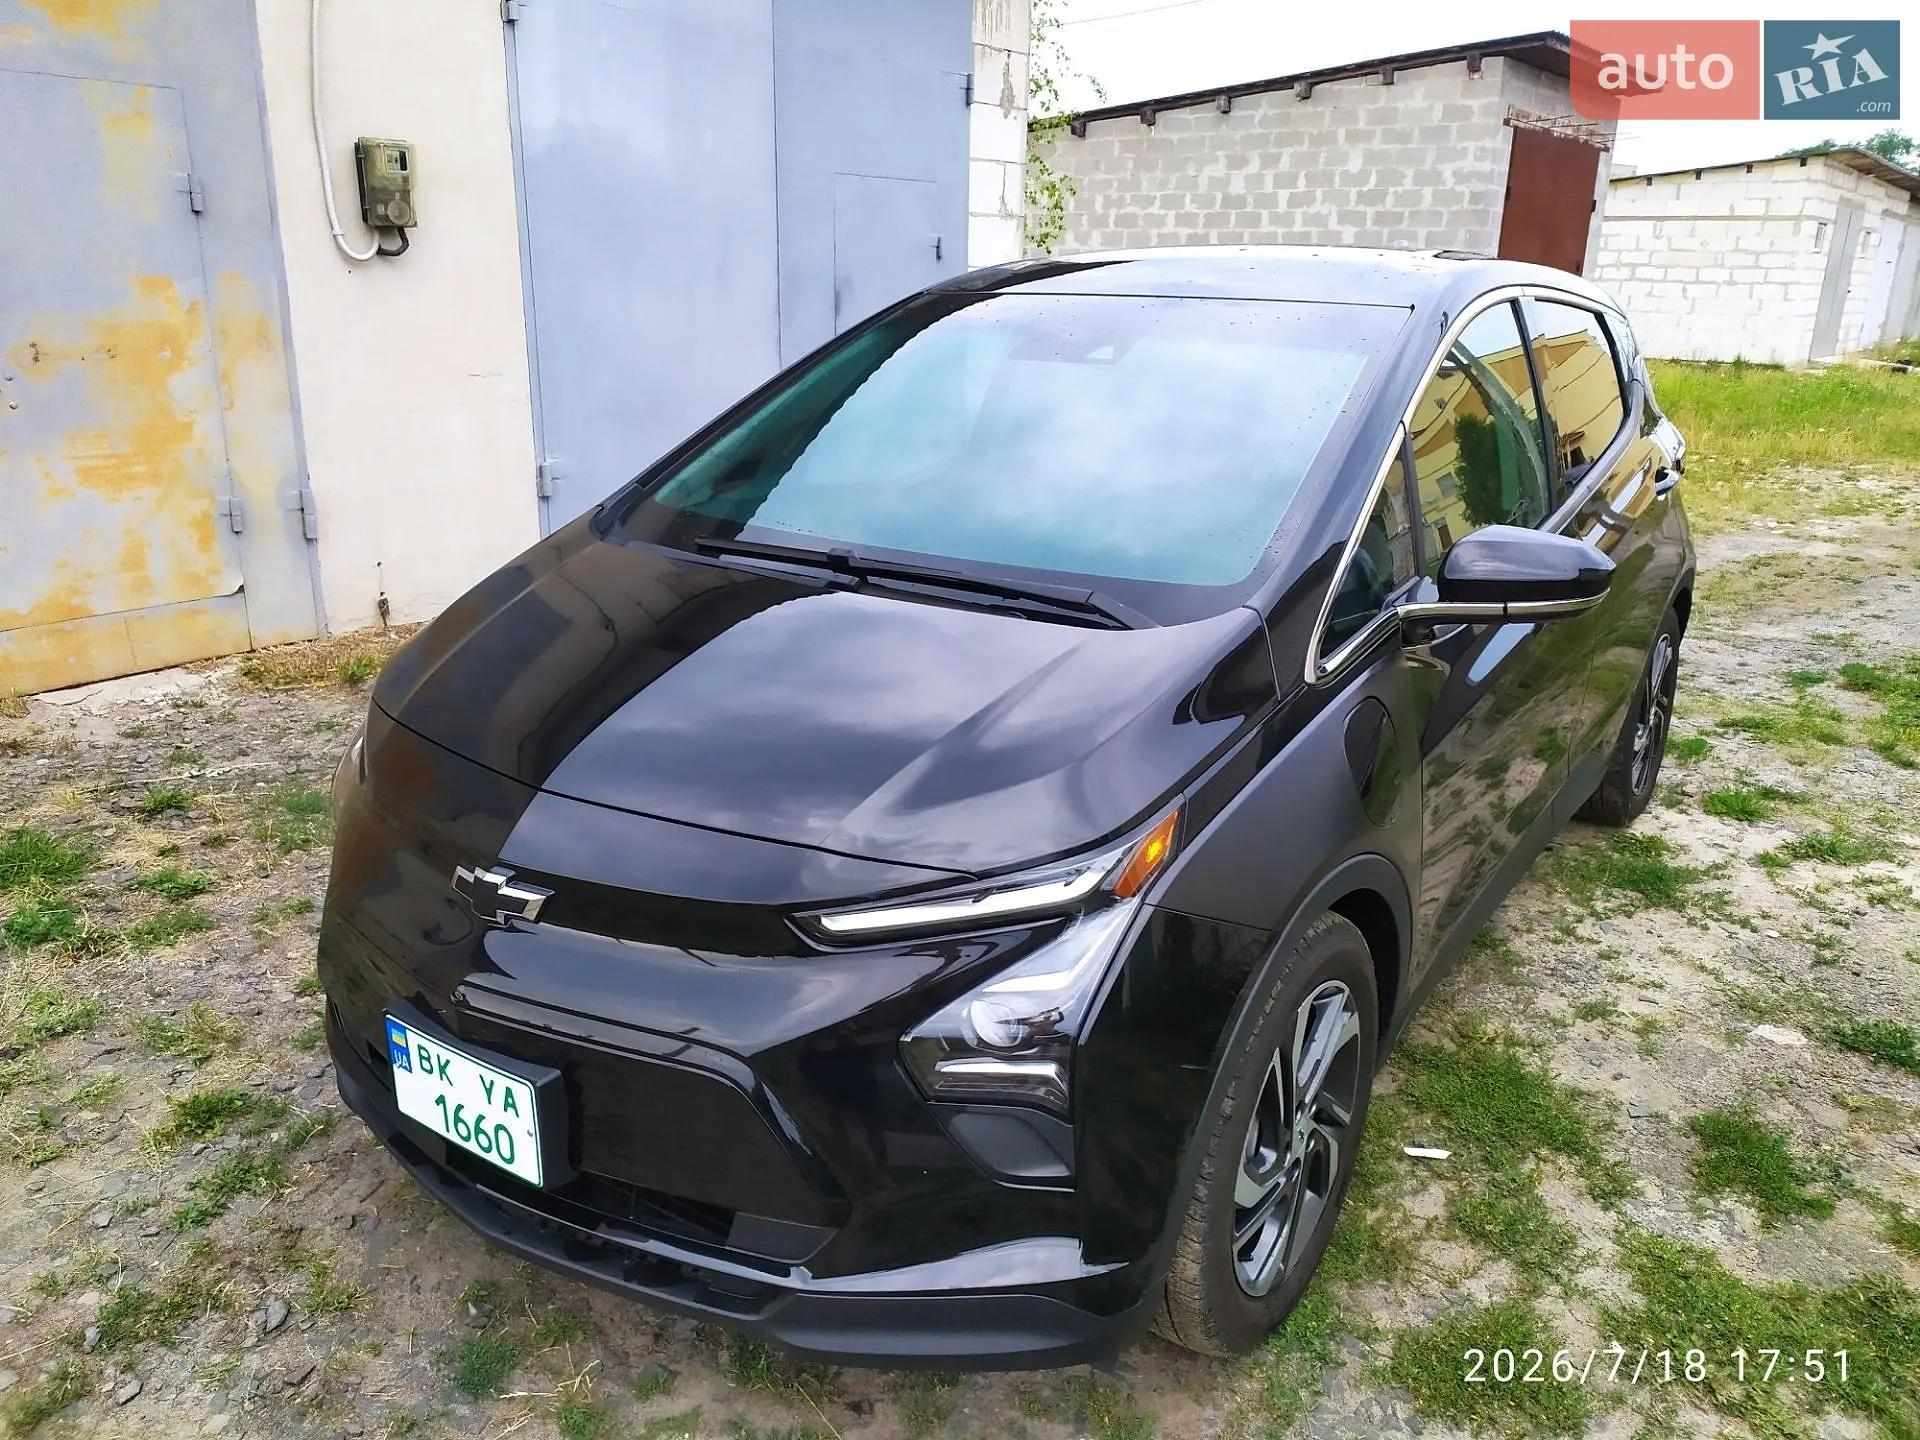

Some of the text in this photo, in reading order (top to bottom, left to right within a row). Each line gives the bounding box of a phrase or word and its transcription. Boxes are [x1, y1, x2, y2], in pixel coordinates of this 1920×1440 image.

[394, 1050, 409, 1069] UA
[417, 1044, 519, 1118] BK YA
[435, 1094, 515, 1165] 1660
